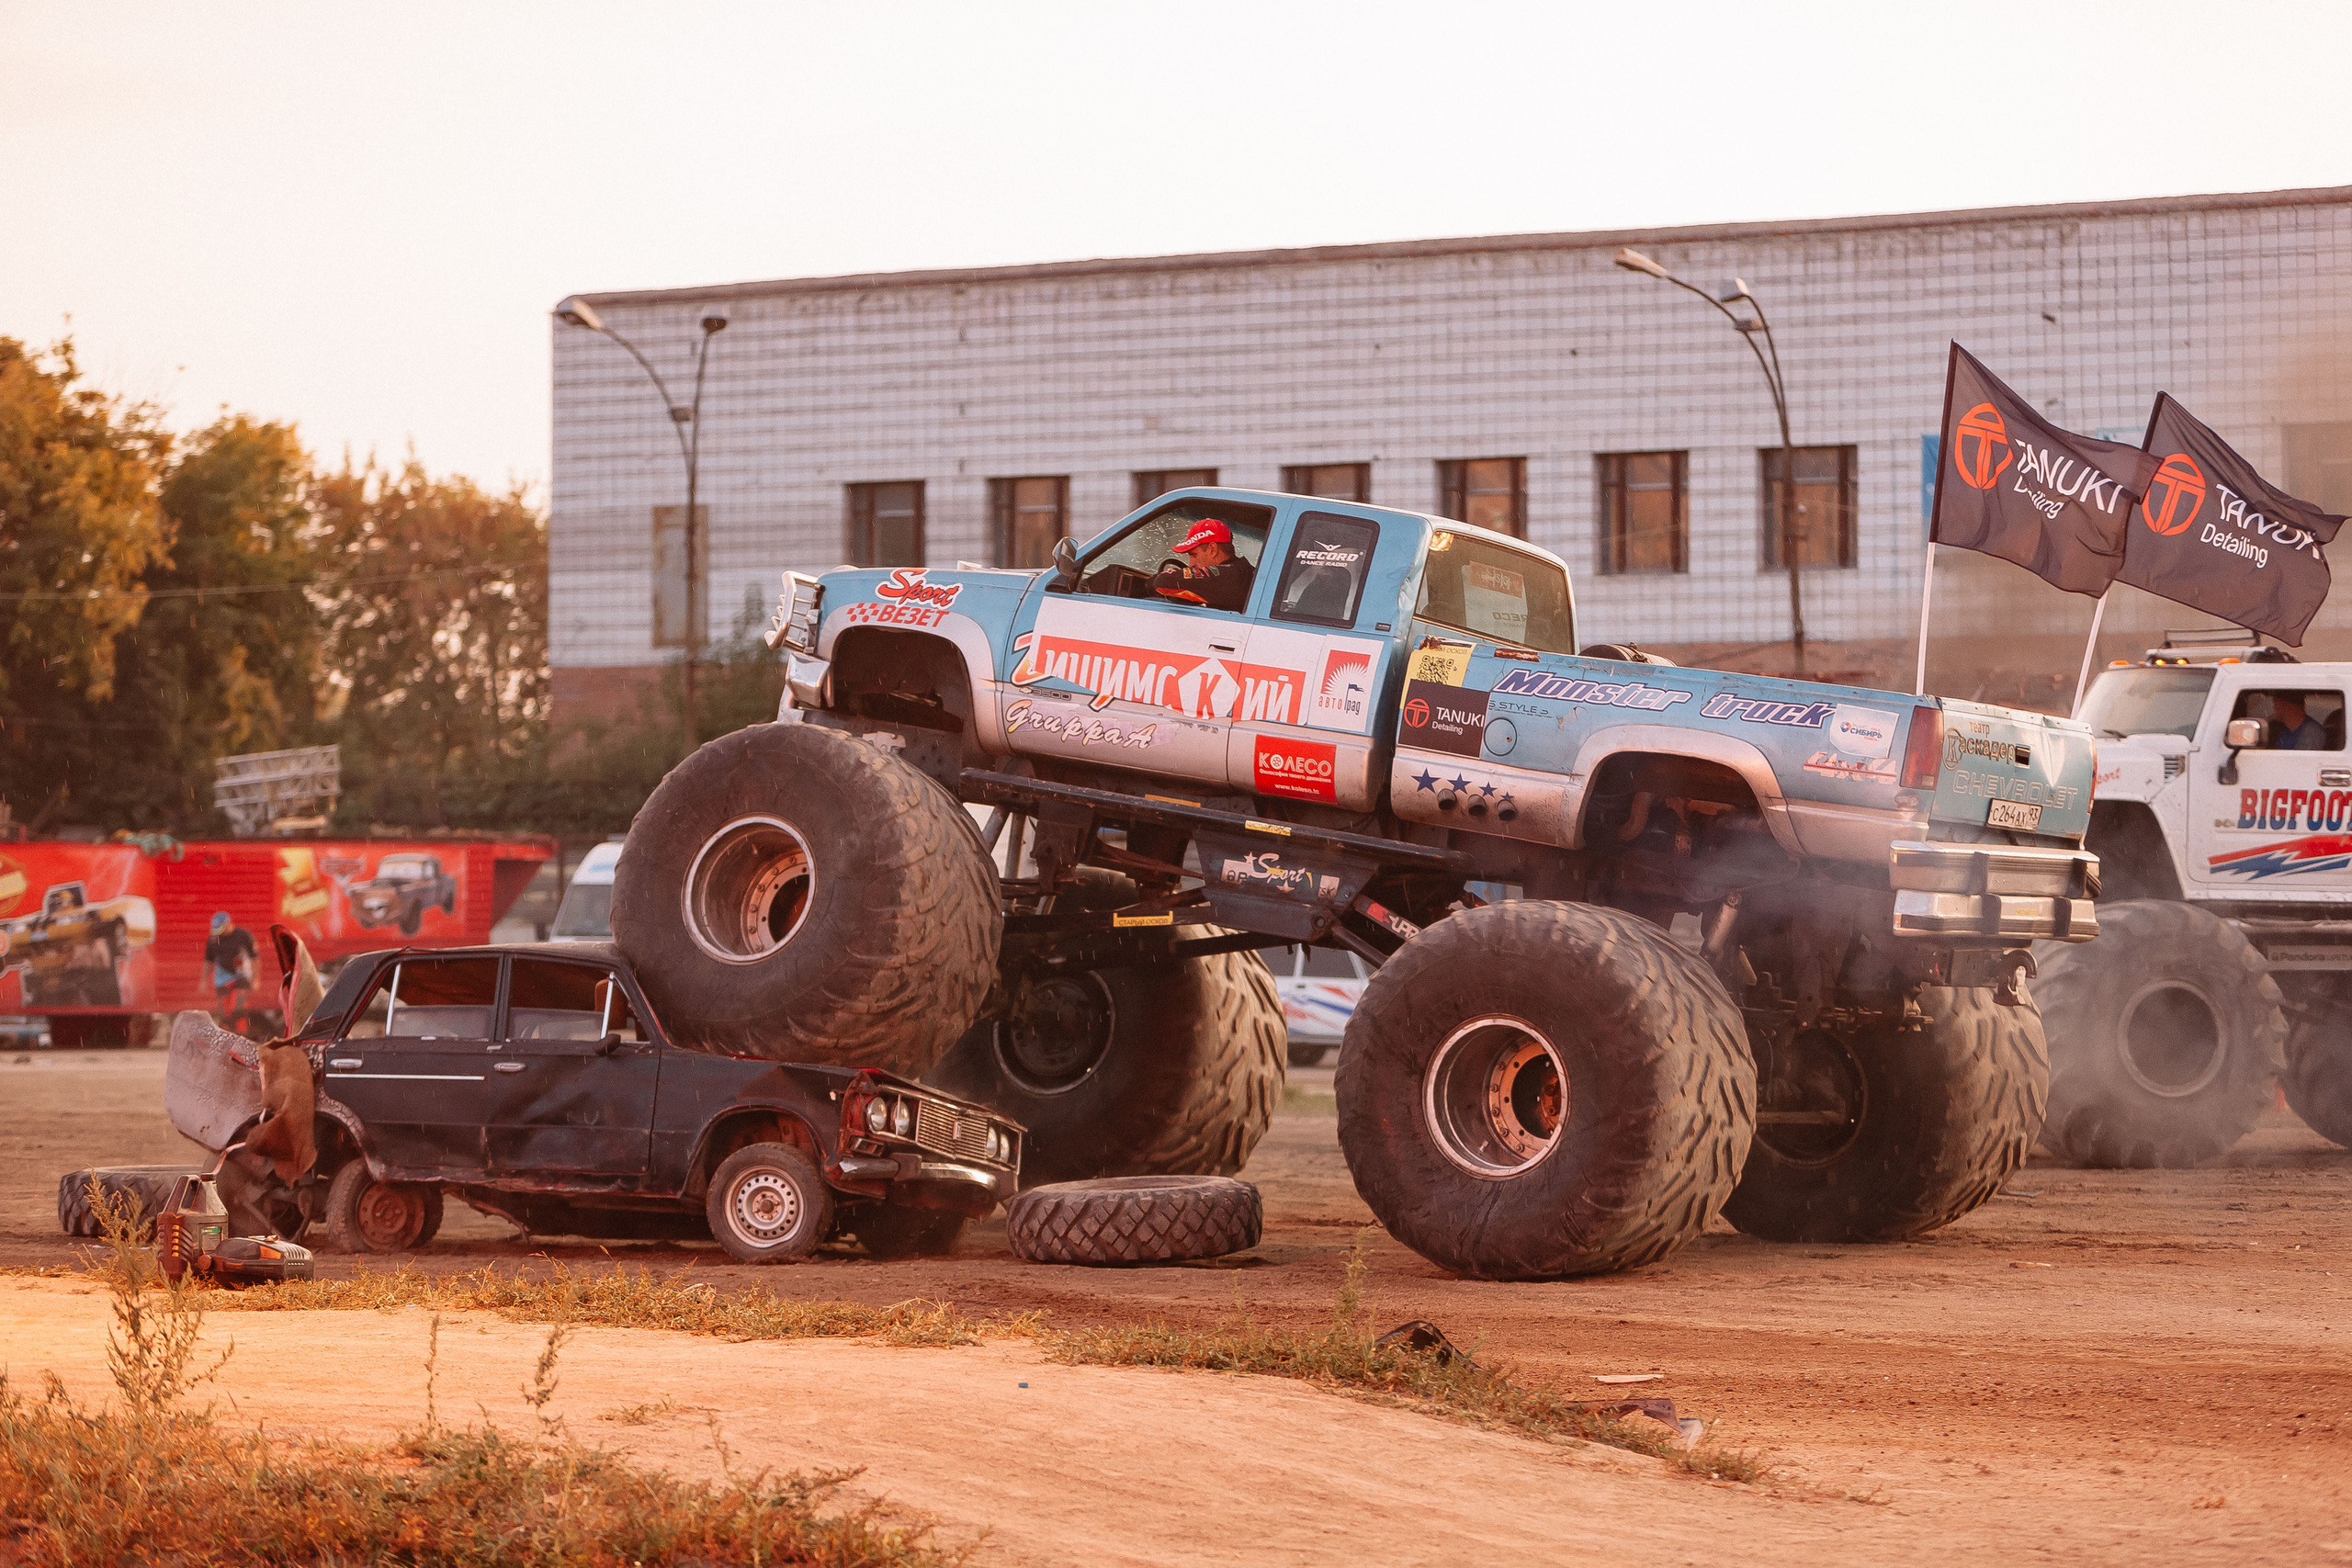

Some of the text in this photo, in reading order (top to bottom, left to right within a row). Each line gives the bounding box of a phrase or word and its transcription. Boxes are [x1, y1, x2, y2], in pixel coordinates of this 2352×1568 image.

[1295, 550, 1359, 562] RECORD
[2200, 524, 2268, 569] Detailing
[876, 568, 961, 608] Sport
[1032, 689, 1071, 701] 3500
[1492, 669, 1838, 728] Monster truck
[1435, 706, 1486, 728] TANUKI
[1499, 702, 1537, 713] STYLE
[1431, 721, 1464, 735] Detailing
[1849, 728, 1883, 739] СИБИРЬ
[1969, 721, 1990, 738] театр
[1259, 751, 1331, 776] КОЛЕСО
[1953, 770, 2079, 809] CHEVROLET
